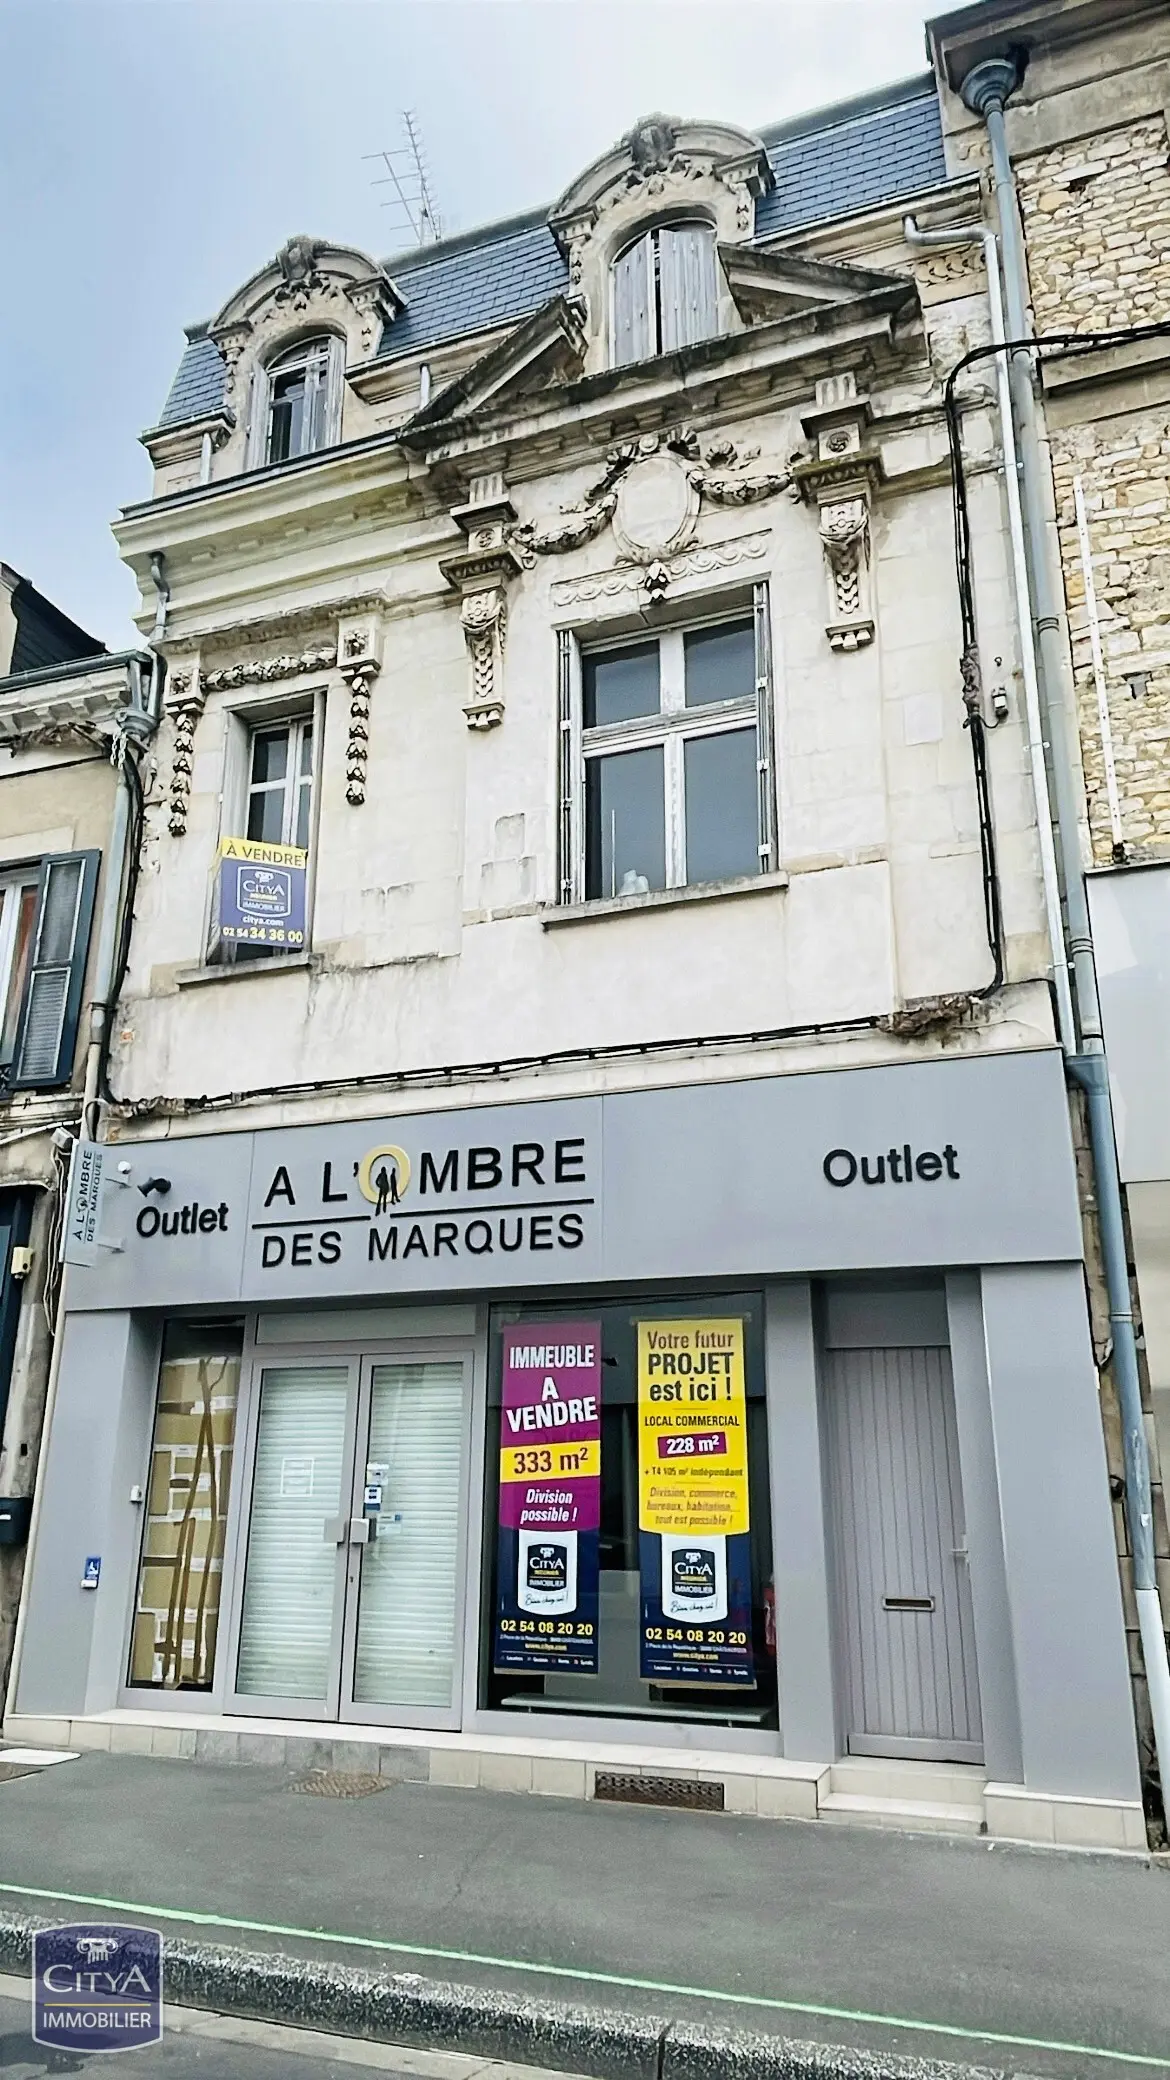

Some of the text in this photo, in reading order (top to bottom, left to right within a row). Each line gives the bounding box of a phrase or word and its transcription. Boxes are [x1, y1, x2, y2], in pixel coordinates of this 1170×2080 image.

[226, 840, 302, 867] À VENDRE
[242, 915, 284, 927] citya.com
[222, 926, 304, 944] 02 54 34 36 00
[264, 1138, 586, 1208] A L'OMBRE
[823, 1144, 960, 1188] Outlet
[86, 1154, 103, 1242] DES MARQUES
[136, 1202, 229, 1238] Outlet
[262, 1213, 585, 1268] DES MARQUES
[647, 1329, 734, 1349] Votre futur
[509, 1345, 595, 1369] IMMEUBLE
[648, 1351, 734, 1375] PROJET
[542, 1376, 559, 1401] A
[650, 1380, 683, 1401] est
[689, 1377, 717, 1401] ici
[506, 1396, 599, 1433] VENDRE
[644, 1415, 740, 1426] LOCAL COMMERCIAL
[666, 1436, 695, 1455] 228
[514, 1450, 552, 1474] 333
[526, 1488, 573, 1504] Division
[520, 1507, 570, 1525] possible
[655, 1515, 673, 1524] tout
[674, 1515, 687, 1525] est
[689, 1515, 727, 1527] possible
[674, 1585, 713, 1594] IMMOBILIER
[501, 1619, 594, 1636] 02 54 08 20 20
[645, 1628, 746, 1644] 02 54 08 20 20
